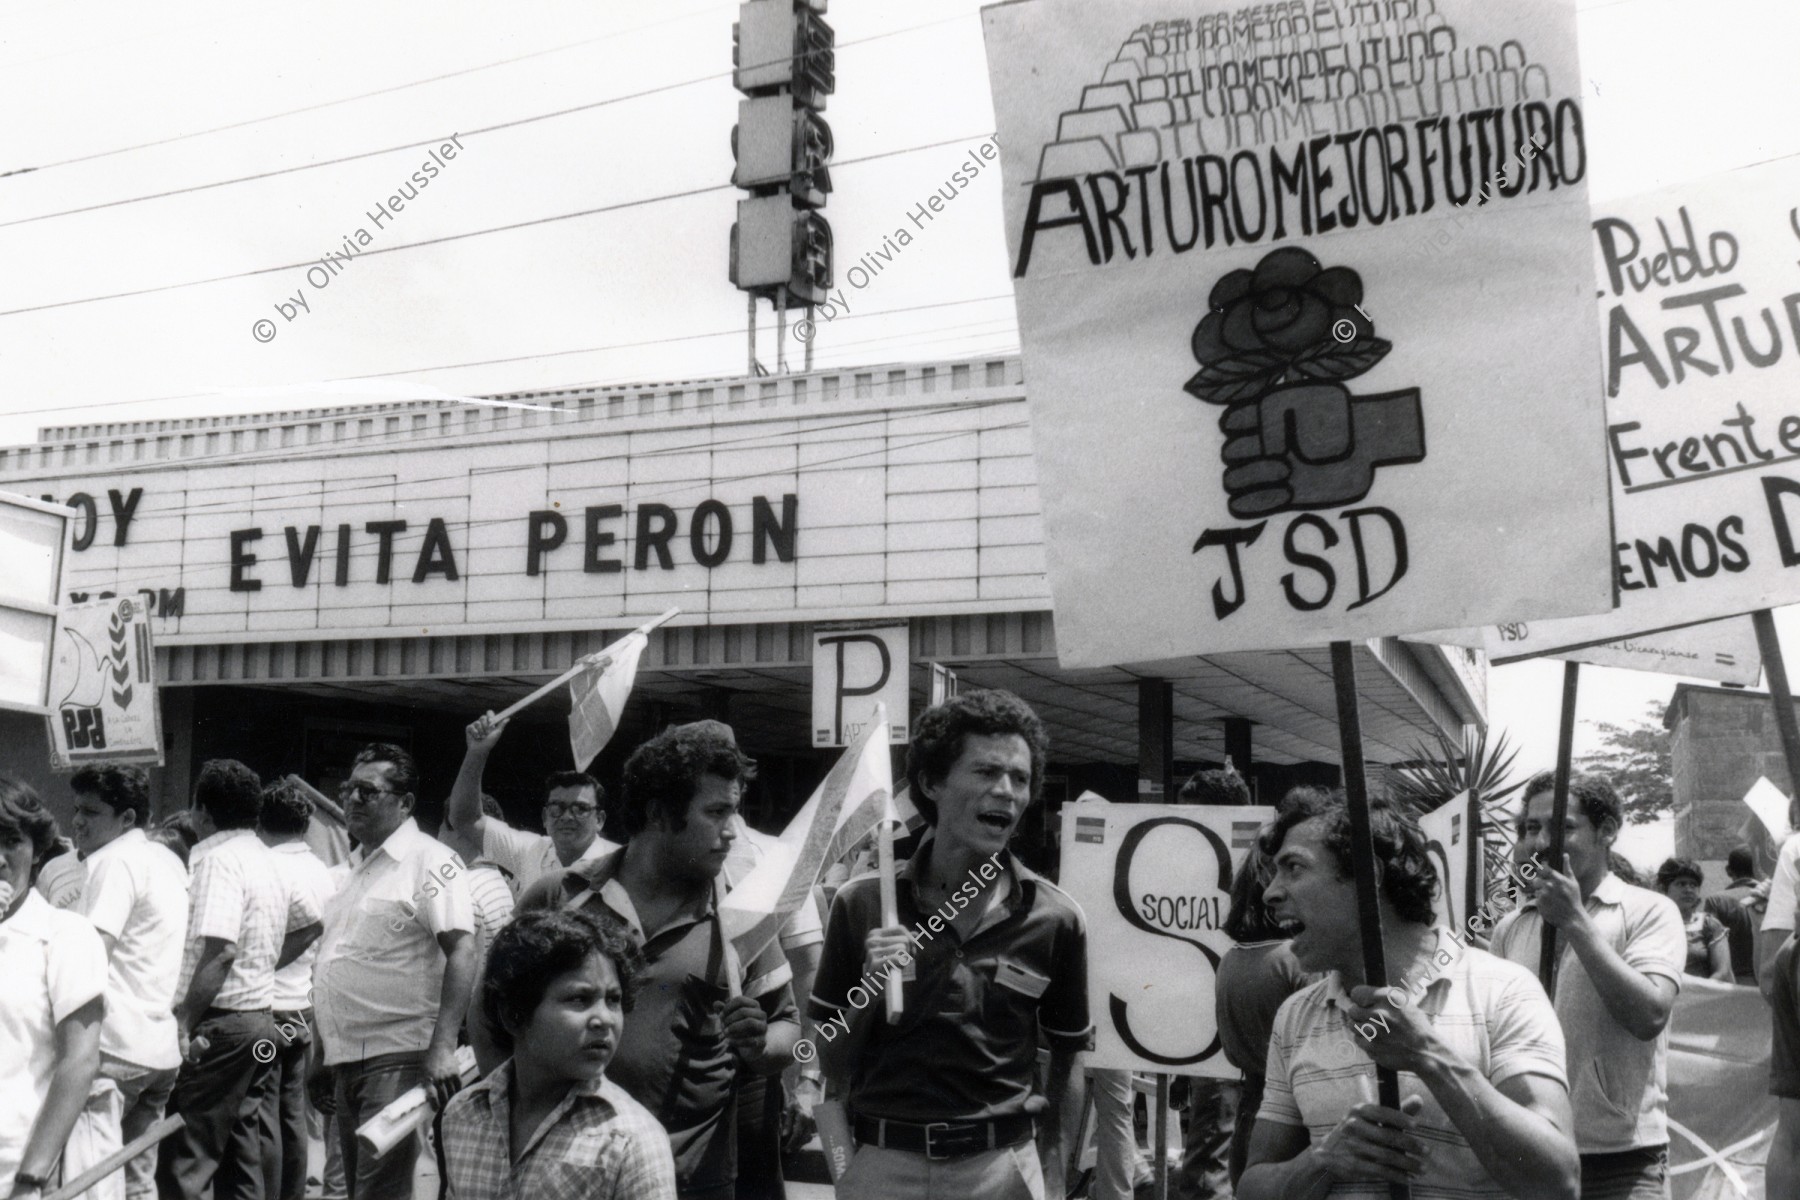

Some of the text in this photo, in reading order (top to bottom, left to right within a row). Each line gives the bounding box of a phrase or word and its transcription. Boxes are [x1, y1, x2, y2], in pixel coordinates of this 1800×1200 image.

[1591, 205, 1739, 297] Pueblo
[1608, 401, 1800, 487] Frente
[229, 493, 798, 592] EVITA PERON
[1192, 506, 1409, 621] JSD
[1496, 621, 1529, 642] PSD
[1141, 893, 1224, 931] SOCIAL
